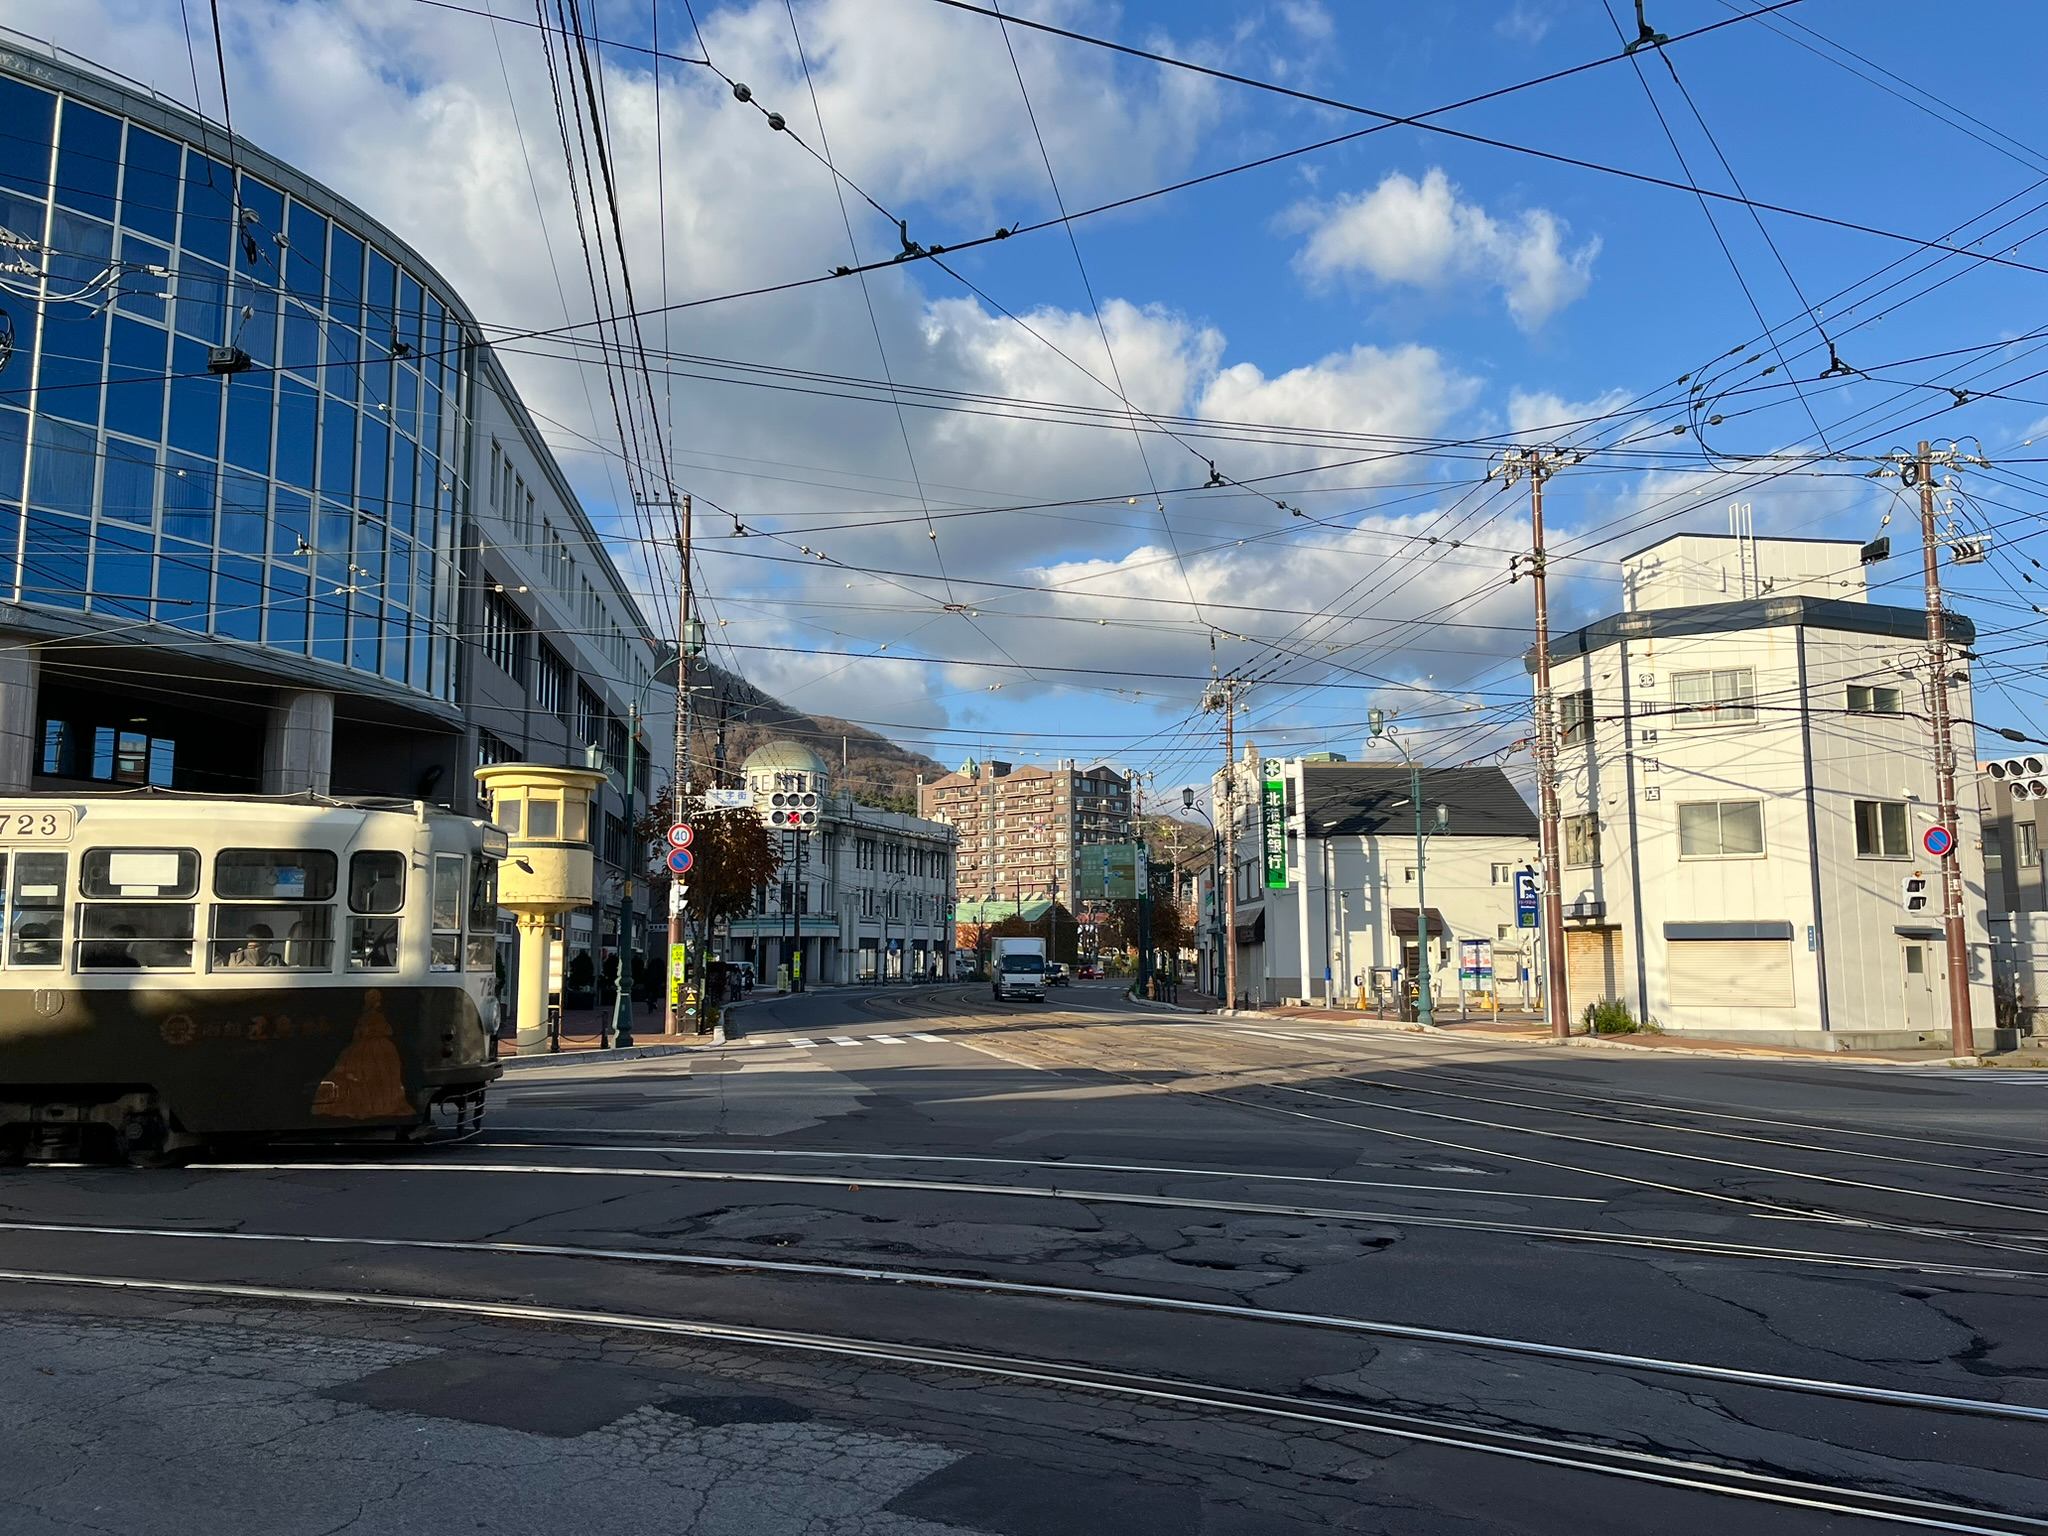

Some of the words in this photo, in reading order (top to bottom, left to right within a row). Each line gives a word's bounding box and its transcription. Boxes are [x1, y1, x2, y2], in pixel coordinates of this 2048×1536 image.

[0, 814, 57, 835] 723
[1265, 791, 1282, 869] 北海道銀行
[674, 830, 688, 842] 40
[480, 977, 497, 997] 72
